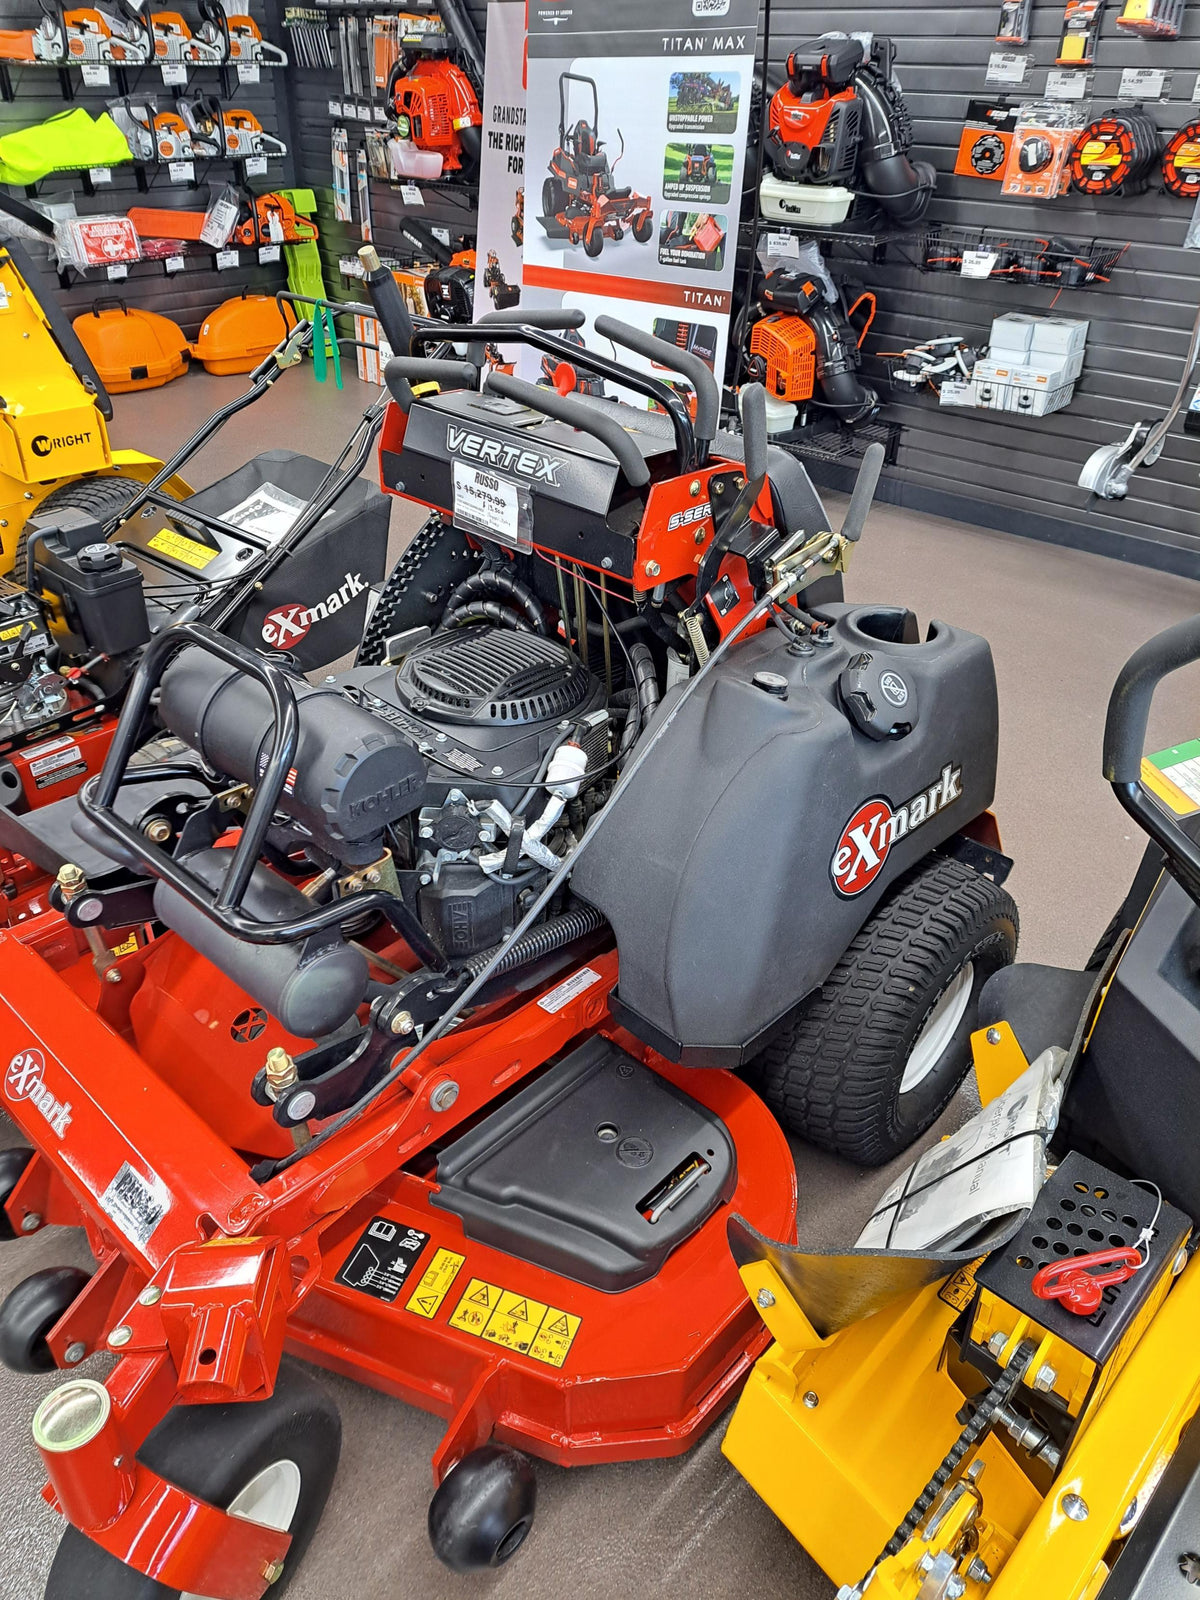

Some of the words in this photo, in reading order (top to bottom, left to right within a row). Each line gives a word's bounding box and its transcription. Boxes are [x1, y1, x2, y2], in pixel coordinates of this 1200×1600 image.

[712, 35, 746, 50] MAX
[669, 114, 698, 122] UNSTOPPABLE
[698, 114, 713, 122] POWER
[488, 131, 504, 150] THE
[505, 133, 525, 153] RIGH
[507, 155, 524, 175] FOR
[664, 182, 678, 190] AMPED
[679, 183, 685, 191] UP
[685, 184, 711, 192] SUSPENSION
[660, 248, 669, 256] FUEL
[670, 249, 680, 257] YOUR
[681, 250, 706, 259] DOMINATION
[31, 432, 91, 457] WRIGHT
[448, 425, 565, 485] VERTEX
[456, 481, 462, 490] $
[474, 472, 499, 491] RUSSO
[262, 573, 365, 647] eXmark
[349, 775, 424, 818] KOHLER
[833, 765, 961, 885] eXmark
[9, 1053, 73, 1139] eXmark
[969, 1155, 992, 1196] anual
